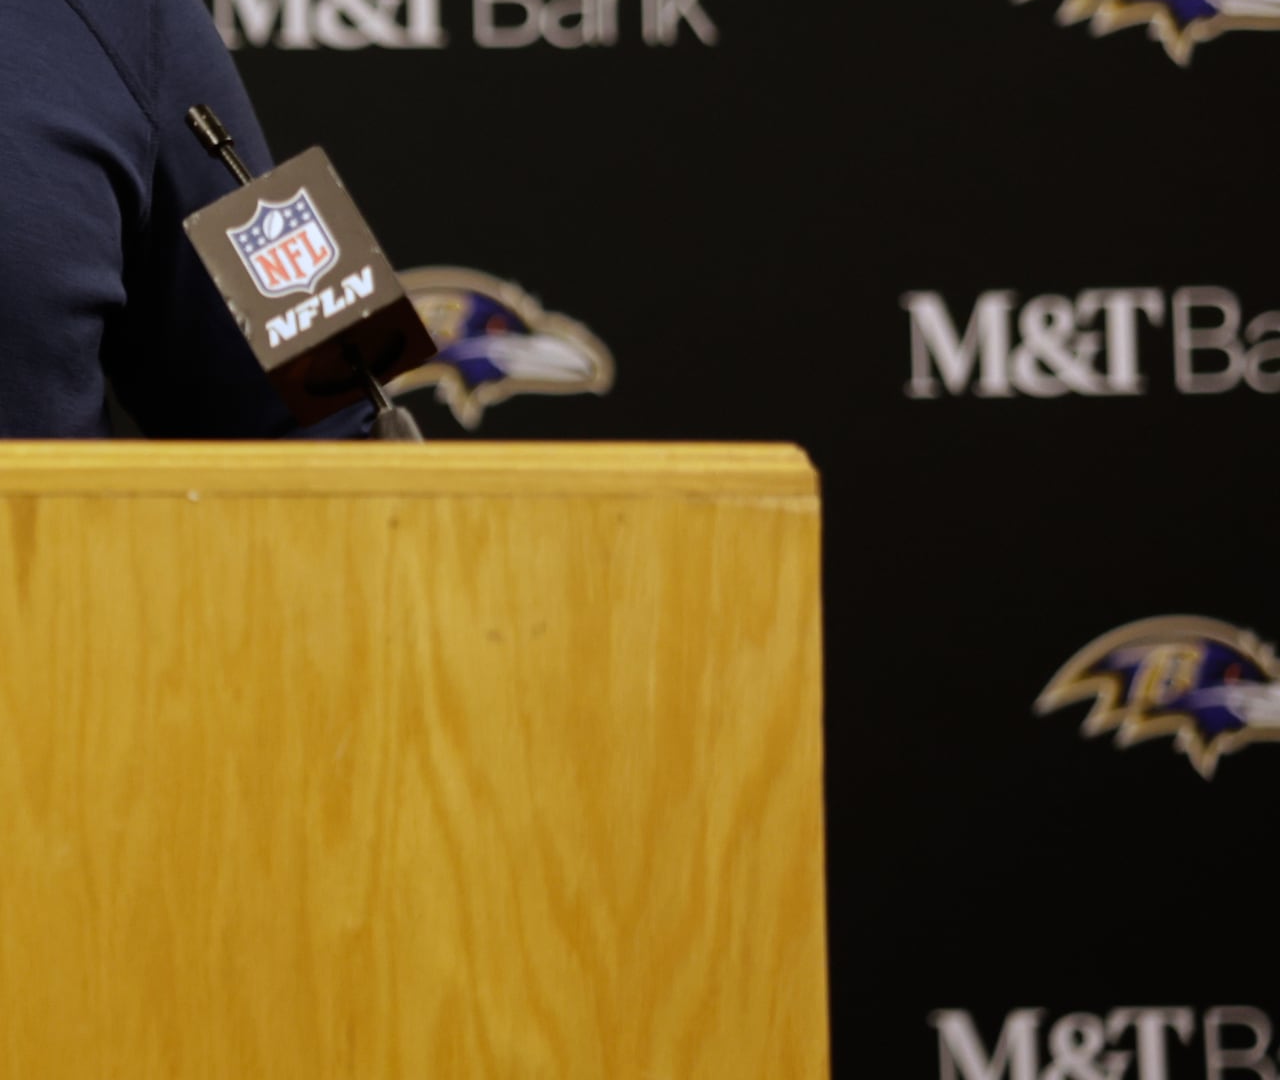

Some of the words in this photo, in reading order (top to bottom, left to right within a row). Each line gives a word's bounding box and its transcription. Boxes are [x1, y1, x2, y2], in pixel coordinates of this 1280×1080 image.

[255, 230, 329, 289] NFL
[265, 265, 374, 348] NFLN
[1171, 284, 1280, 395] Ba
